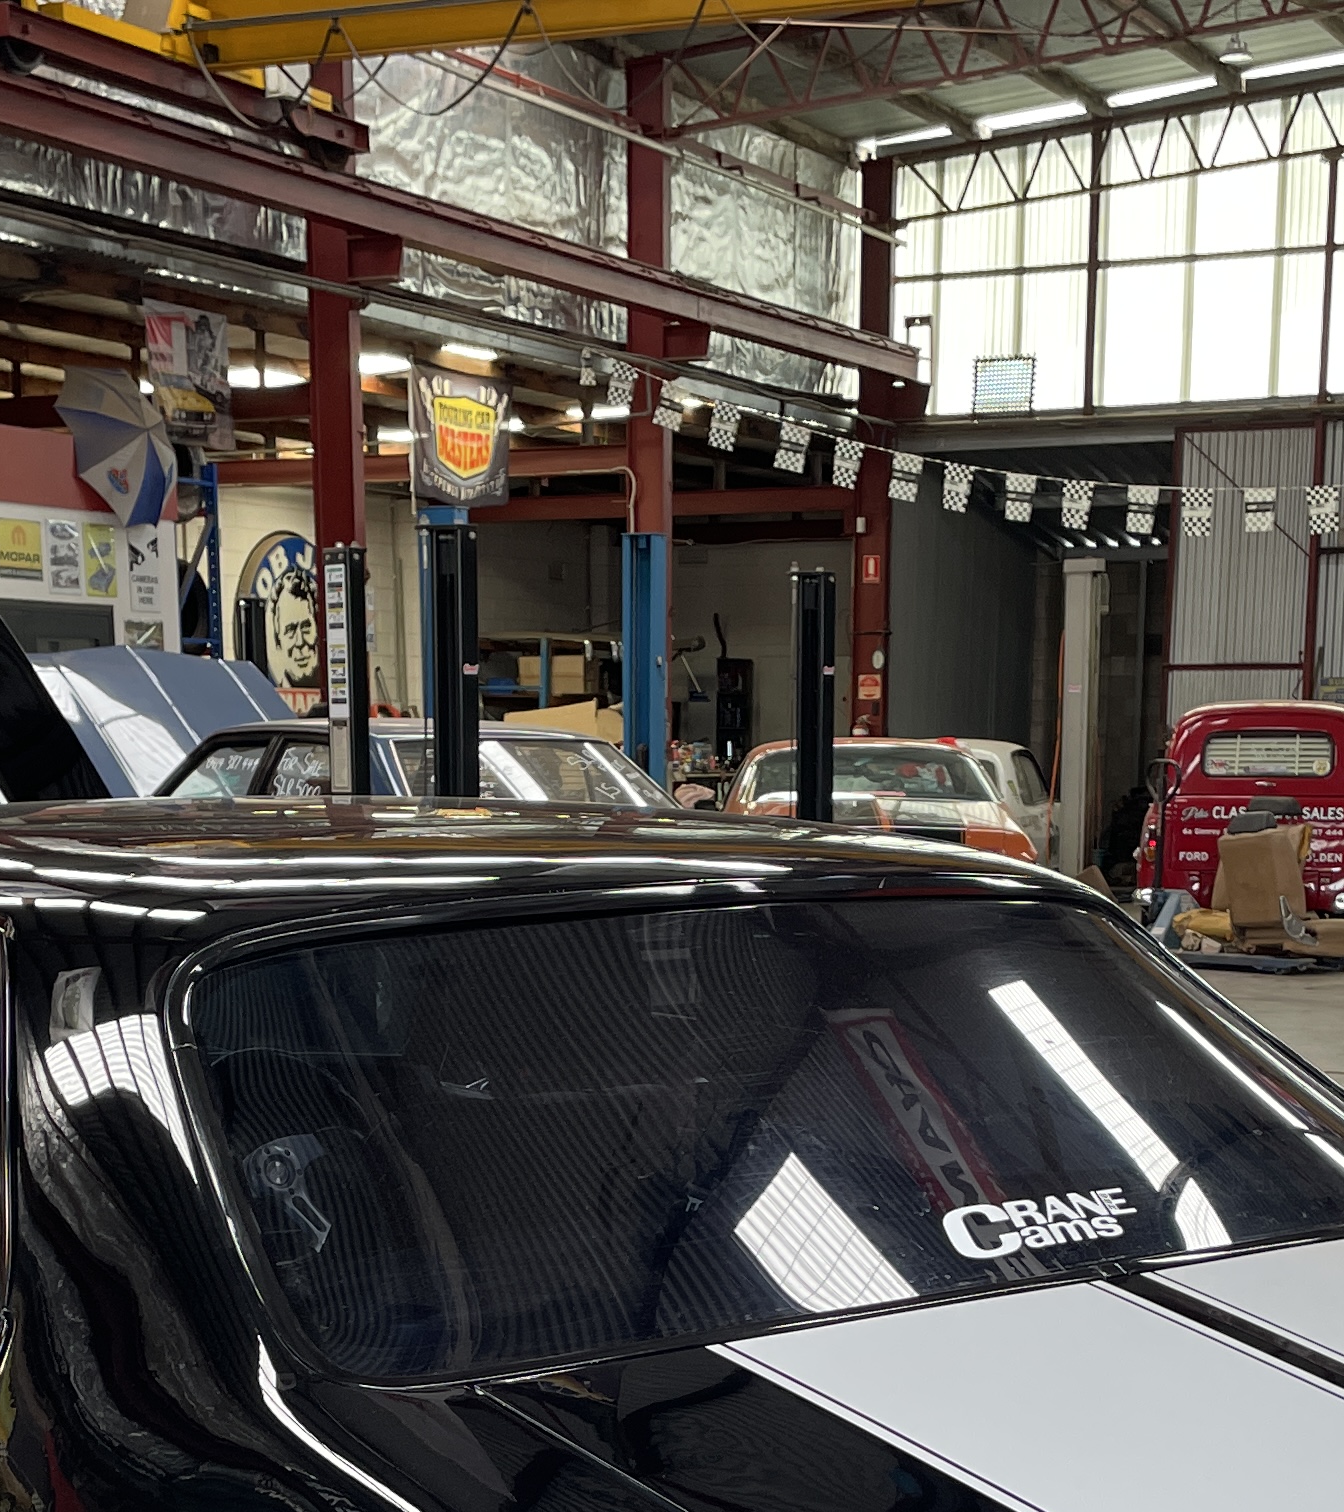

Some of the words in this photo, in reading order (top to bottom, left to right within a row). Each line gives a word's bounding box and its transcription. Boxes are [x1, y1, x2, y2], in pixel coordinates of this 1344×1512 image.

[0, 551, 41, 564] MOPAR
[1301, 806, 1344, 820] SALES
[1178, 851, 1209, 861] FORD
[1305, 852, 1343, 863] OLDEN
